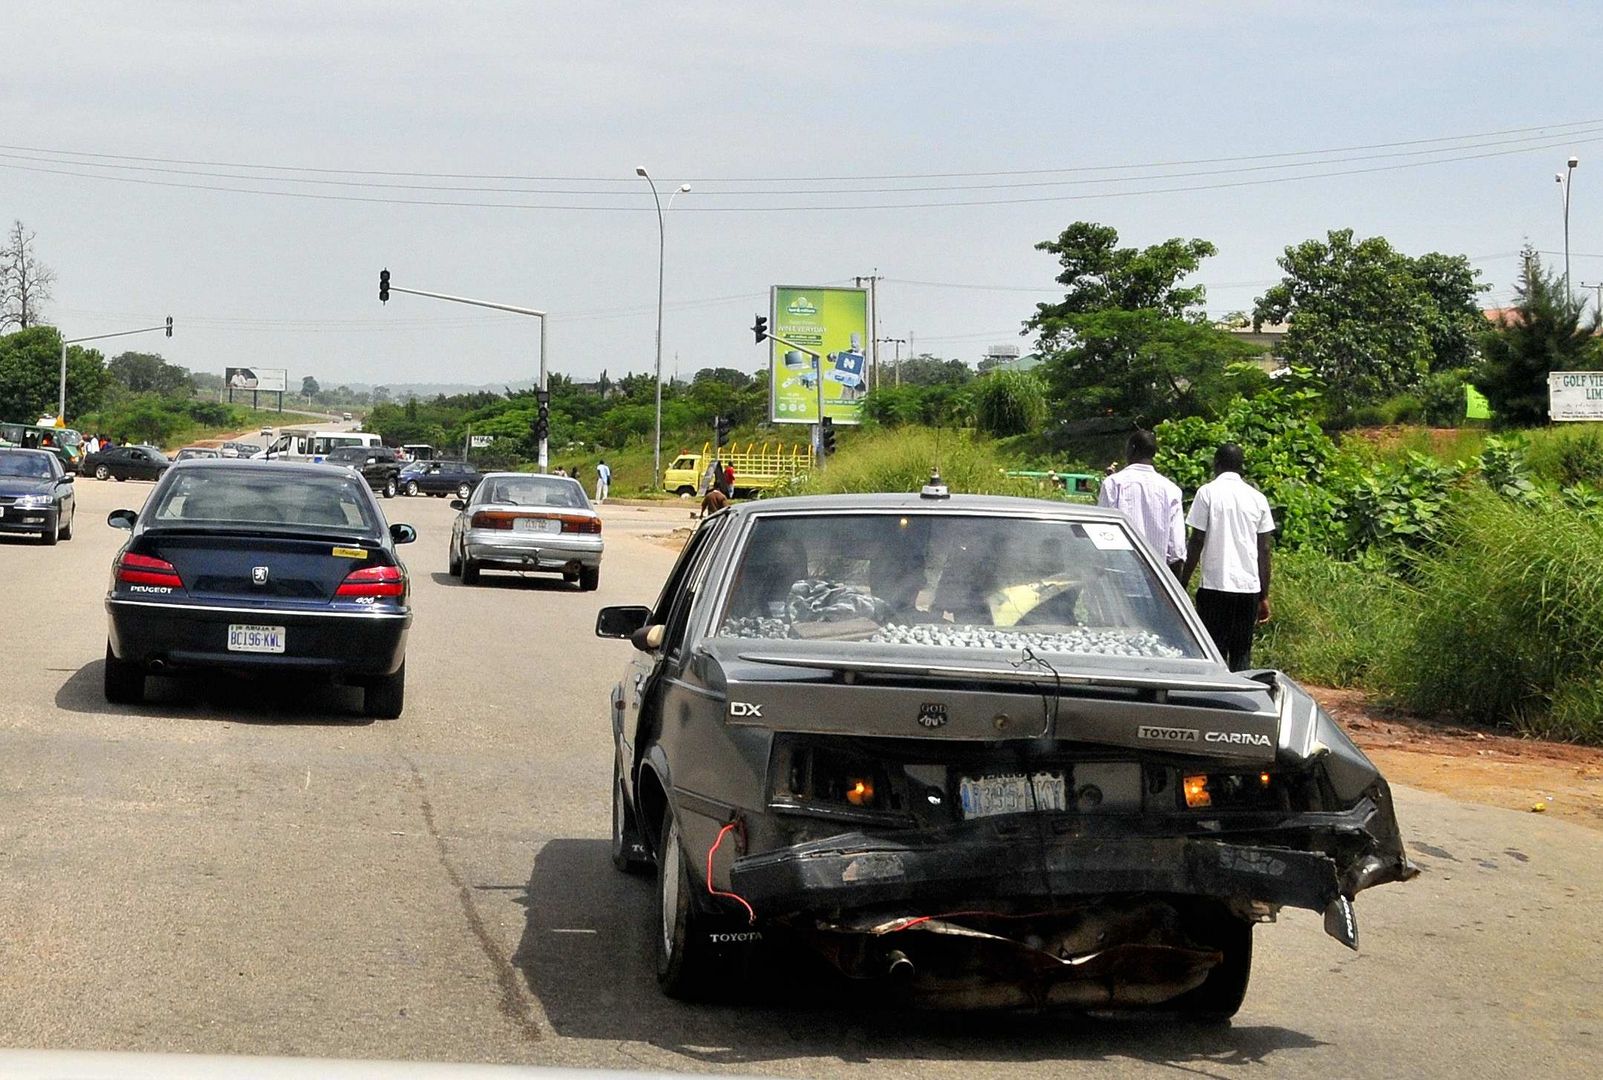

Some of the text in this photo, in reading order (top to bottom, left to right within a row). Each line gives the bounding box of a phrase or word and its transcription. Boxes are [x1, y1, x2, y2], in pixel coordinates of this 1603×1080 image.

[1563, 375, 1586, 387] GOLF
[130, 586, 173, 594] PEUGEOT
[230, 631, 281, 648] BC196-KWL
[730, 701, 763, 717] DX
[921, 703, 947, 713] GOD
[1142, 728, 1272, 747] TOYOTA CARINA
[709, 932, 763, 943] TOYOTA
